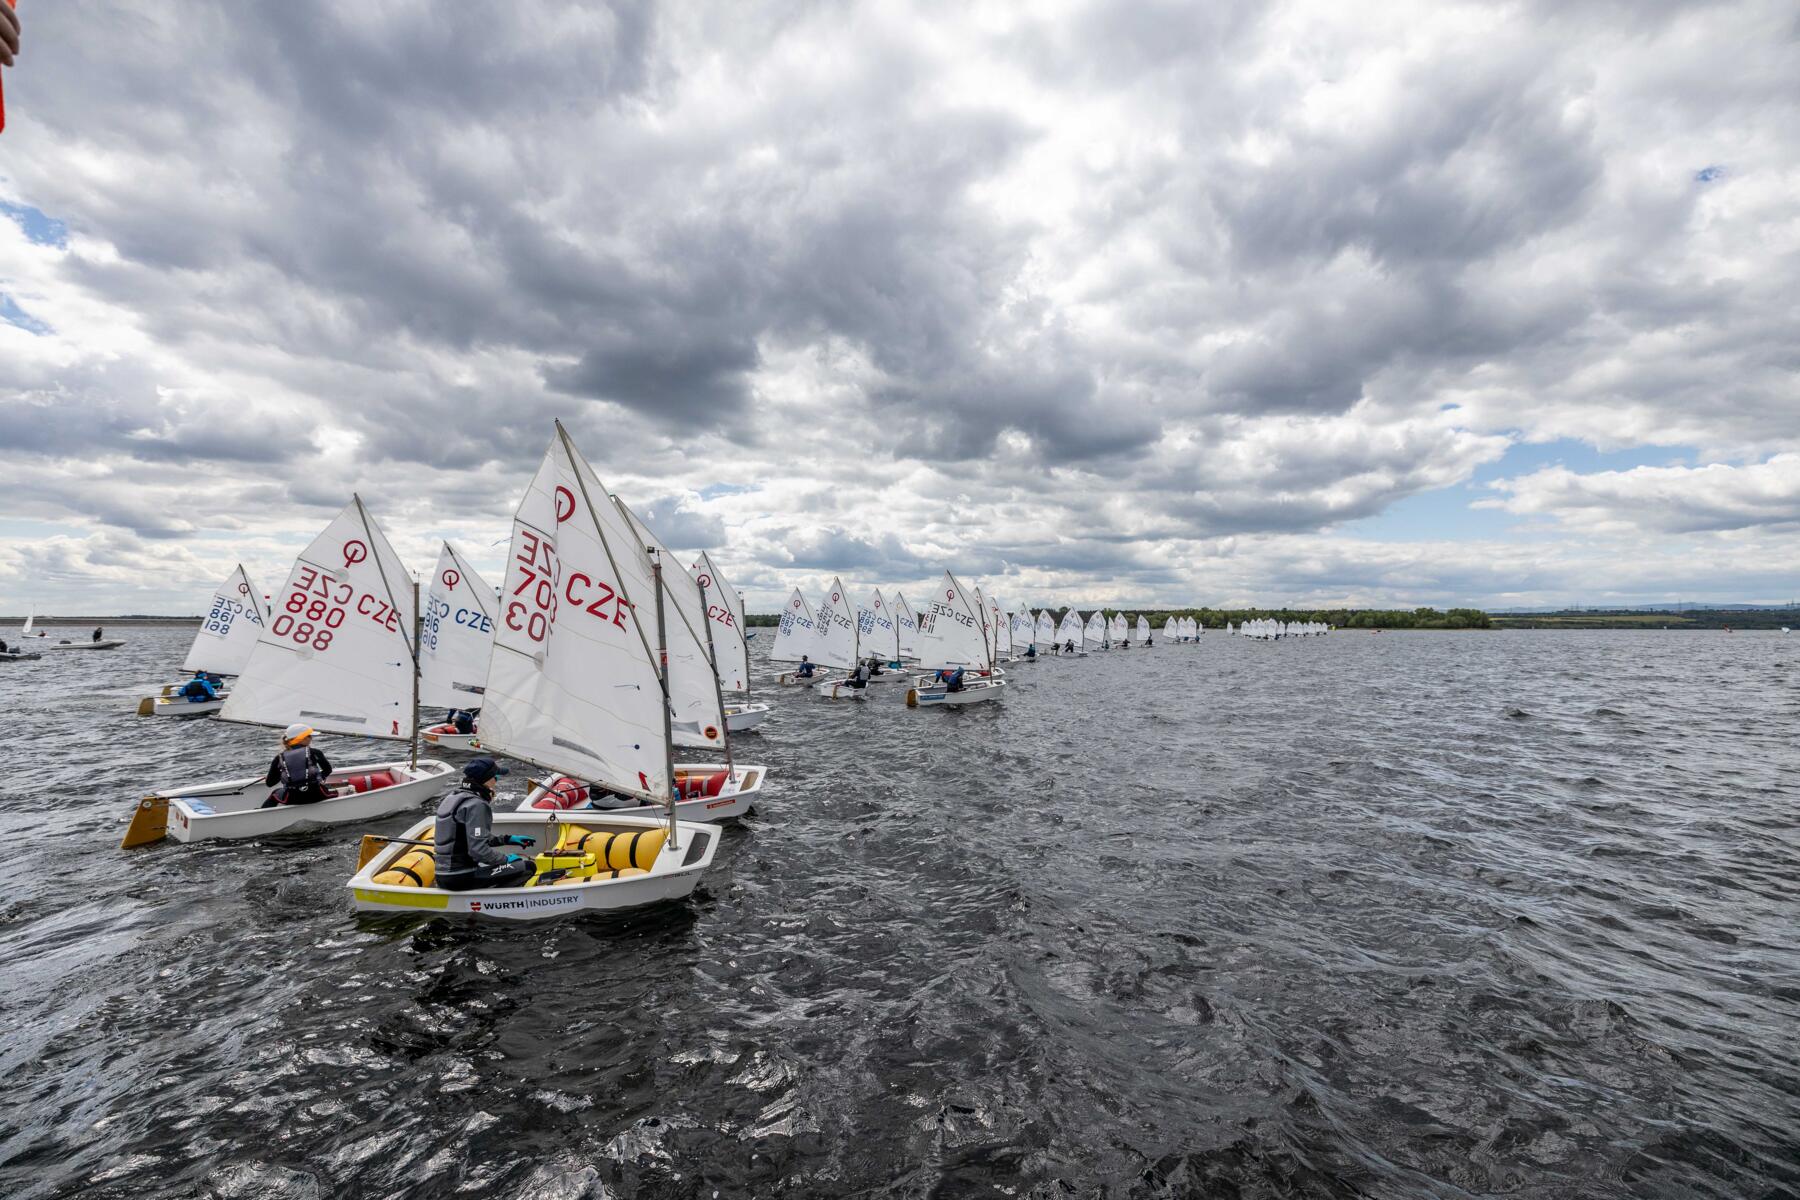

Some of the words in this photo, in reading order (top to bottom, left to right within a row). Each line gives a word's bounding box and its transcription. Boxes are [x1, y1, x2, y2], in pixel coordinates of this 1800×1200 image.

[286, 592, 345, 628] 880
[565, 573, 635, 634] CZE
[210, 608, 235, 624] 861
[357, 594, 401, 633] CZE
[455, 608, 492, 633] CZE
[708, 606, 735, 627] CZE
[955, 612, 974, 627] CZE
[796, 617, 813, 629] CZE
[834, 614, 852, 629] CZE
[876, 617, 892, 630] CZE
[900, 617, 914, 628] CZE
[530, 895, 579, 908] INDUSTRY
